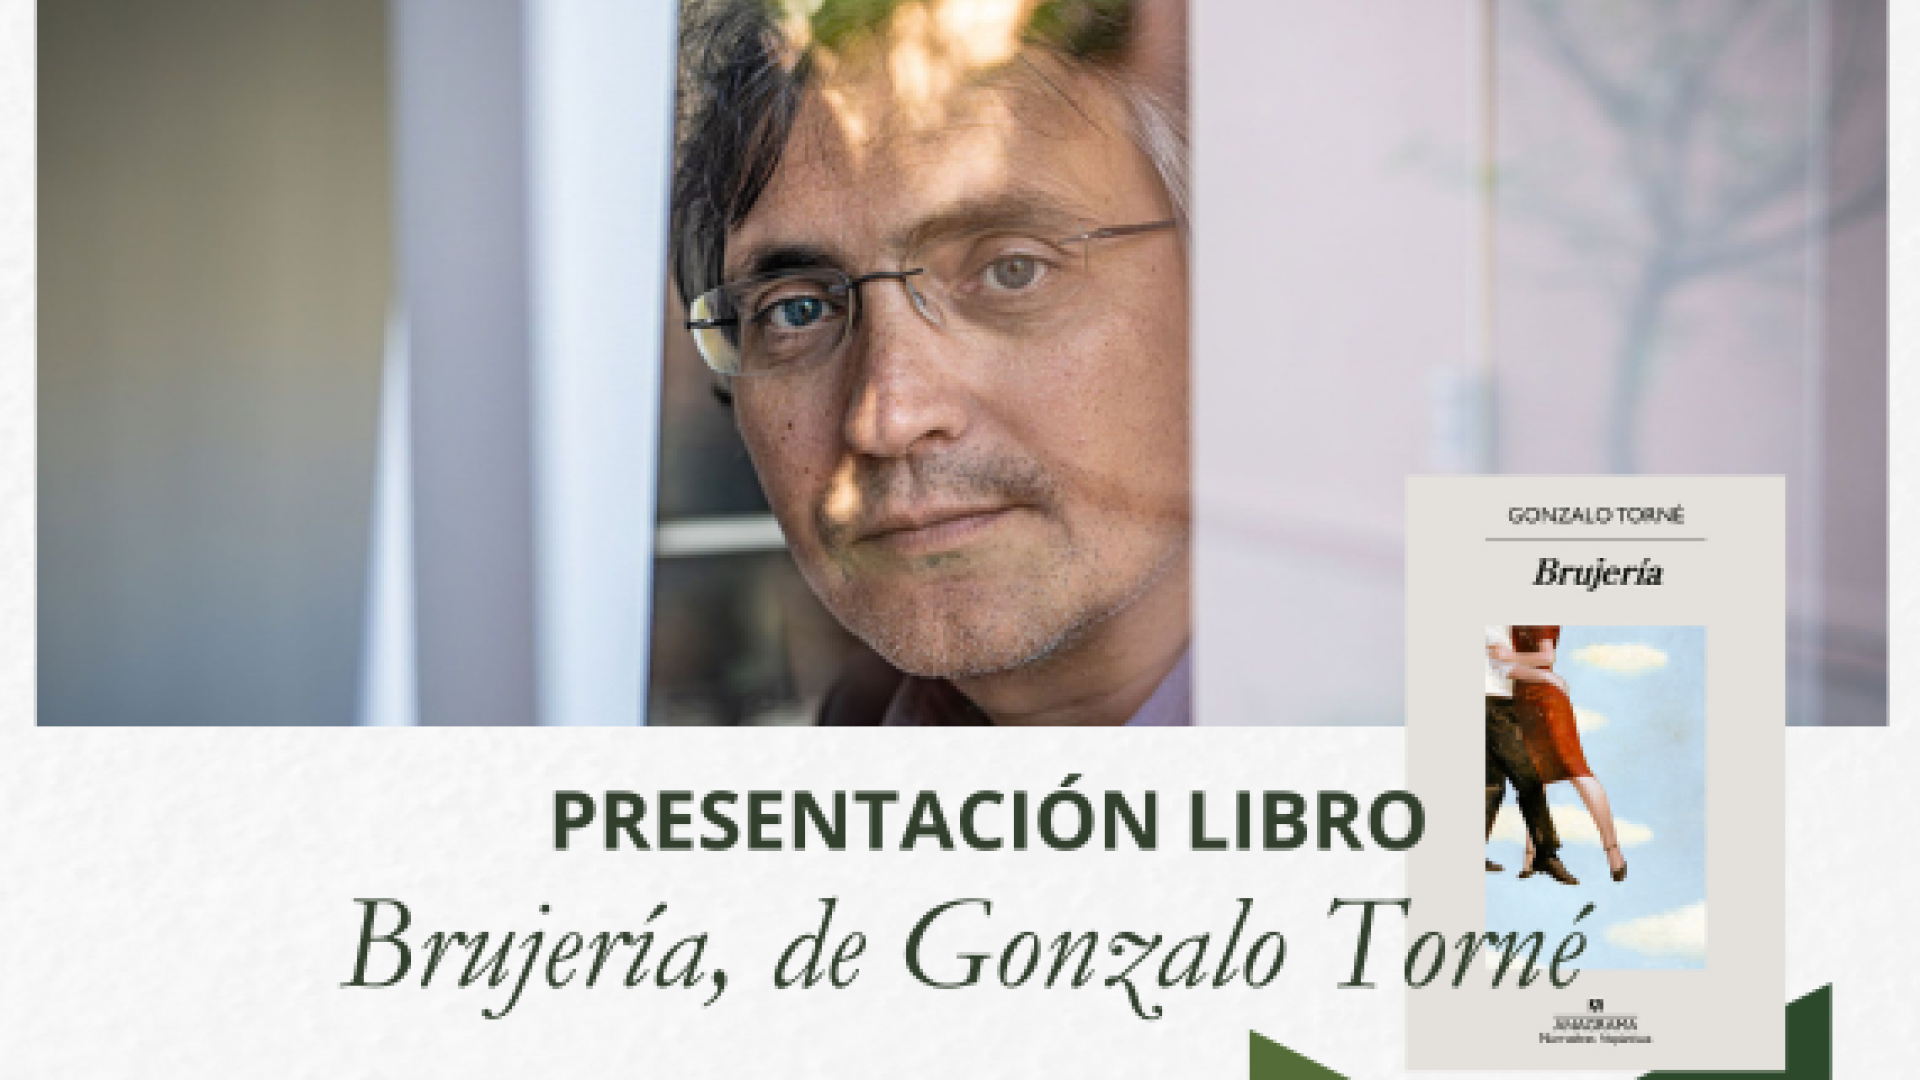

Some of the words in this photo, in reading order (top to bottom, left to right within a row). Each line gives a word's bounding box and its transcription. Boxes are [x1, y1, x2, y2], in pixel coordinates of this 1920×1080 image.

[1507, 505, 1614, 525] GONZALO
[1616, 503, 1686, 525] TORNÉ
[1532, 557, 1665, 593] Brujería
